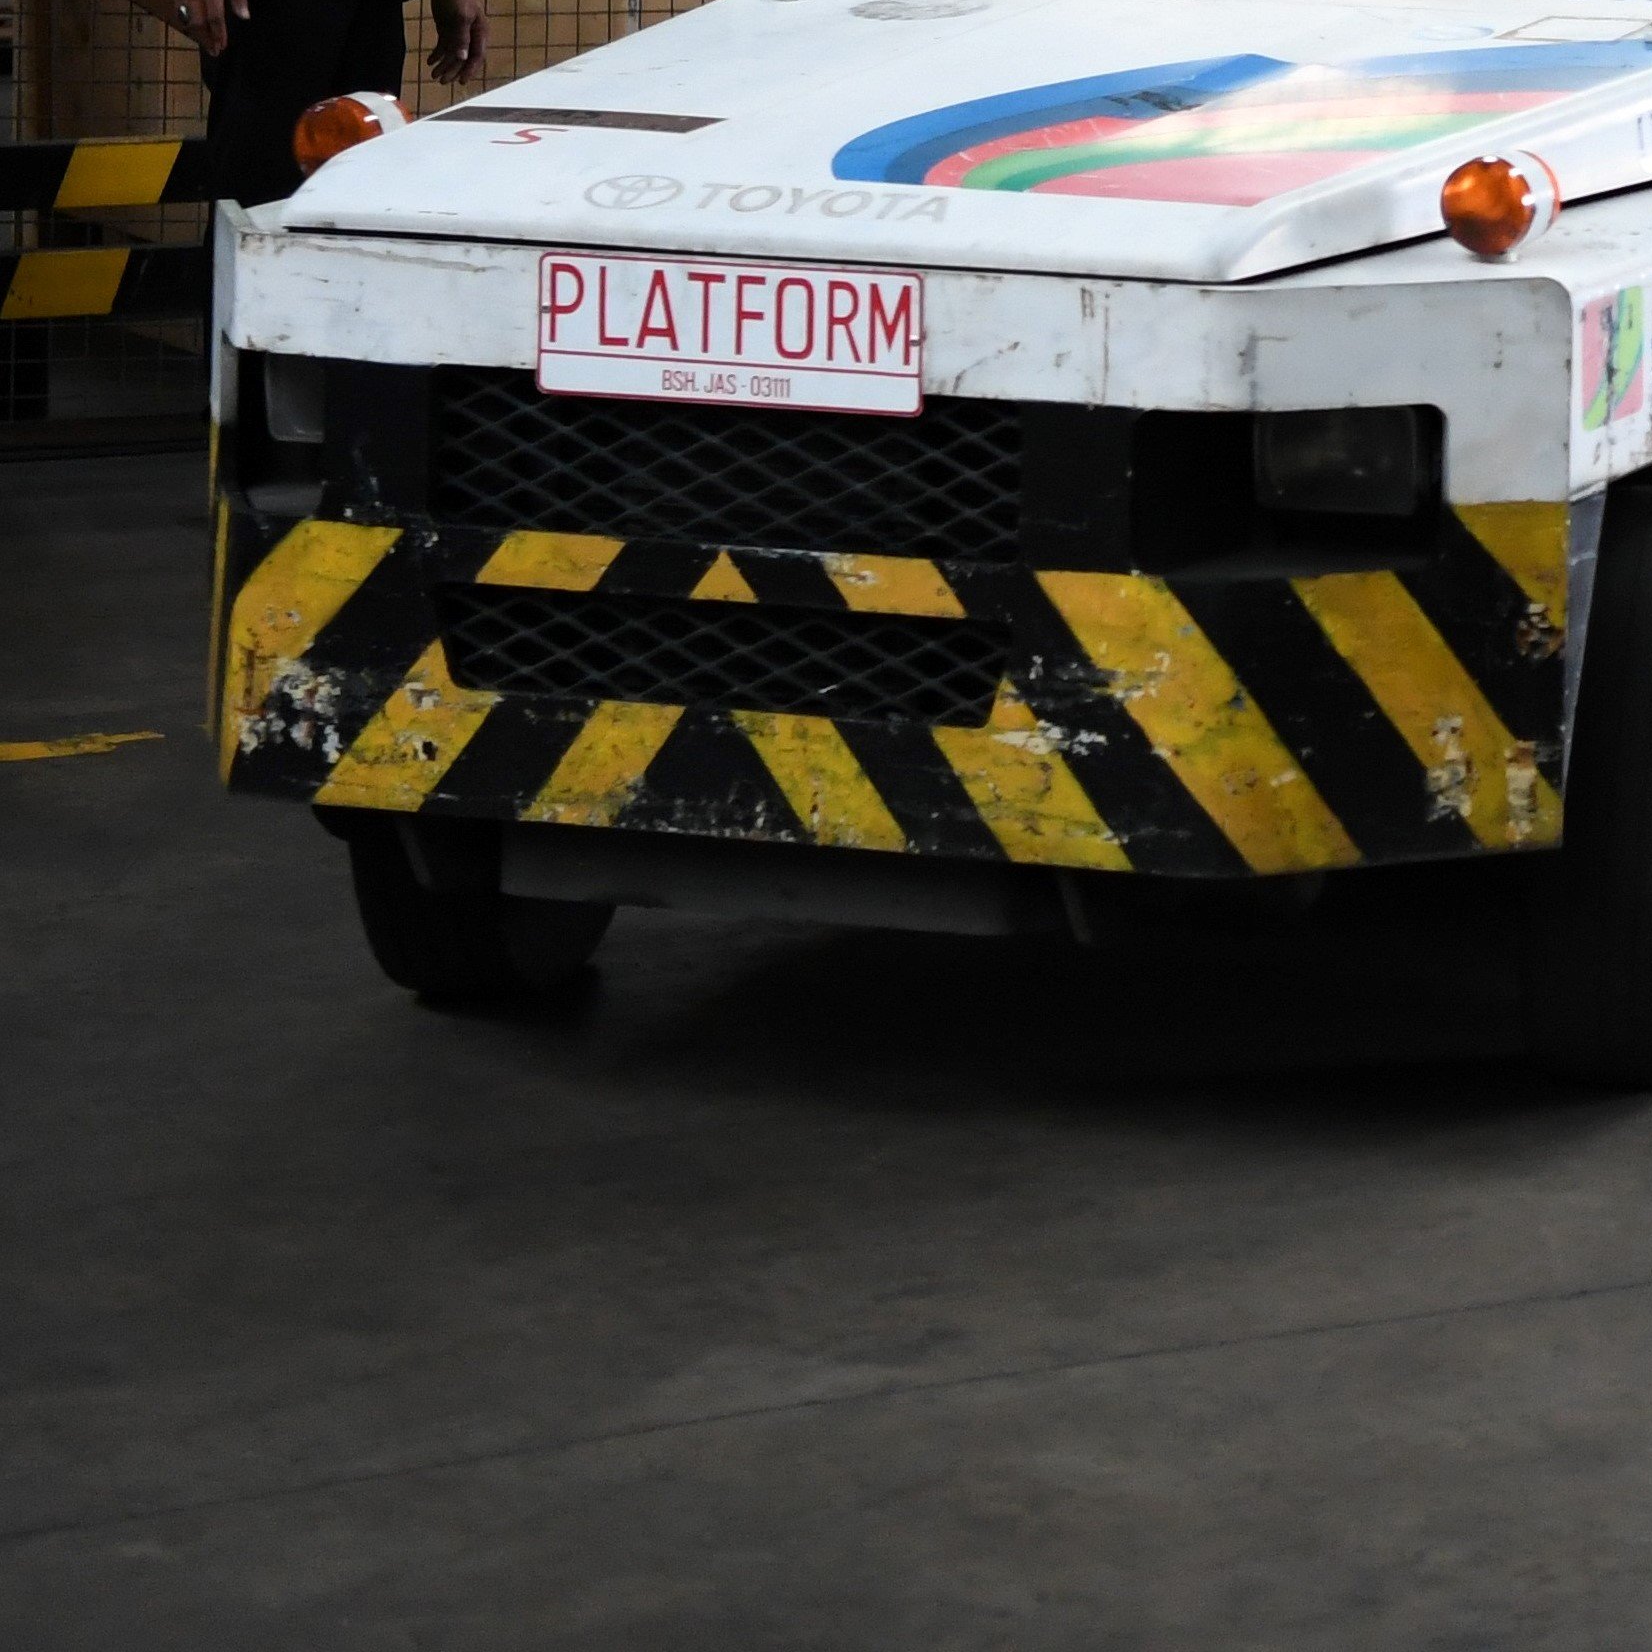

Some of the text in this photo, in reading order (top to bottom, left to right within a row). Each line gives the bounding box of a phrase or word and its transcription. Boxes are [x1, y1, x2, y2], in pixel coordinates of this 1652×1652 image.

[695, 182, 951, 223] TOYOTA
[548, 262, 912, 366] PLATFORM
[704, 374, 737, 395] JAS
